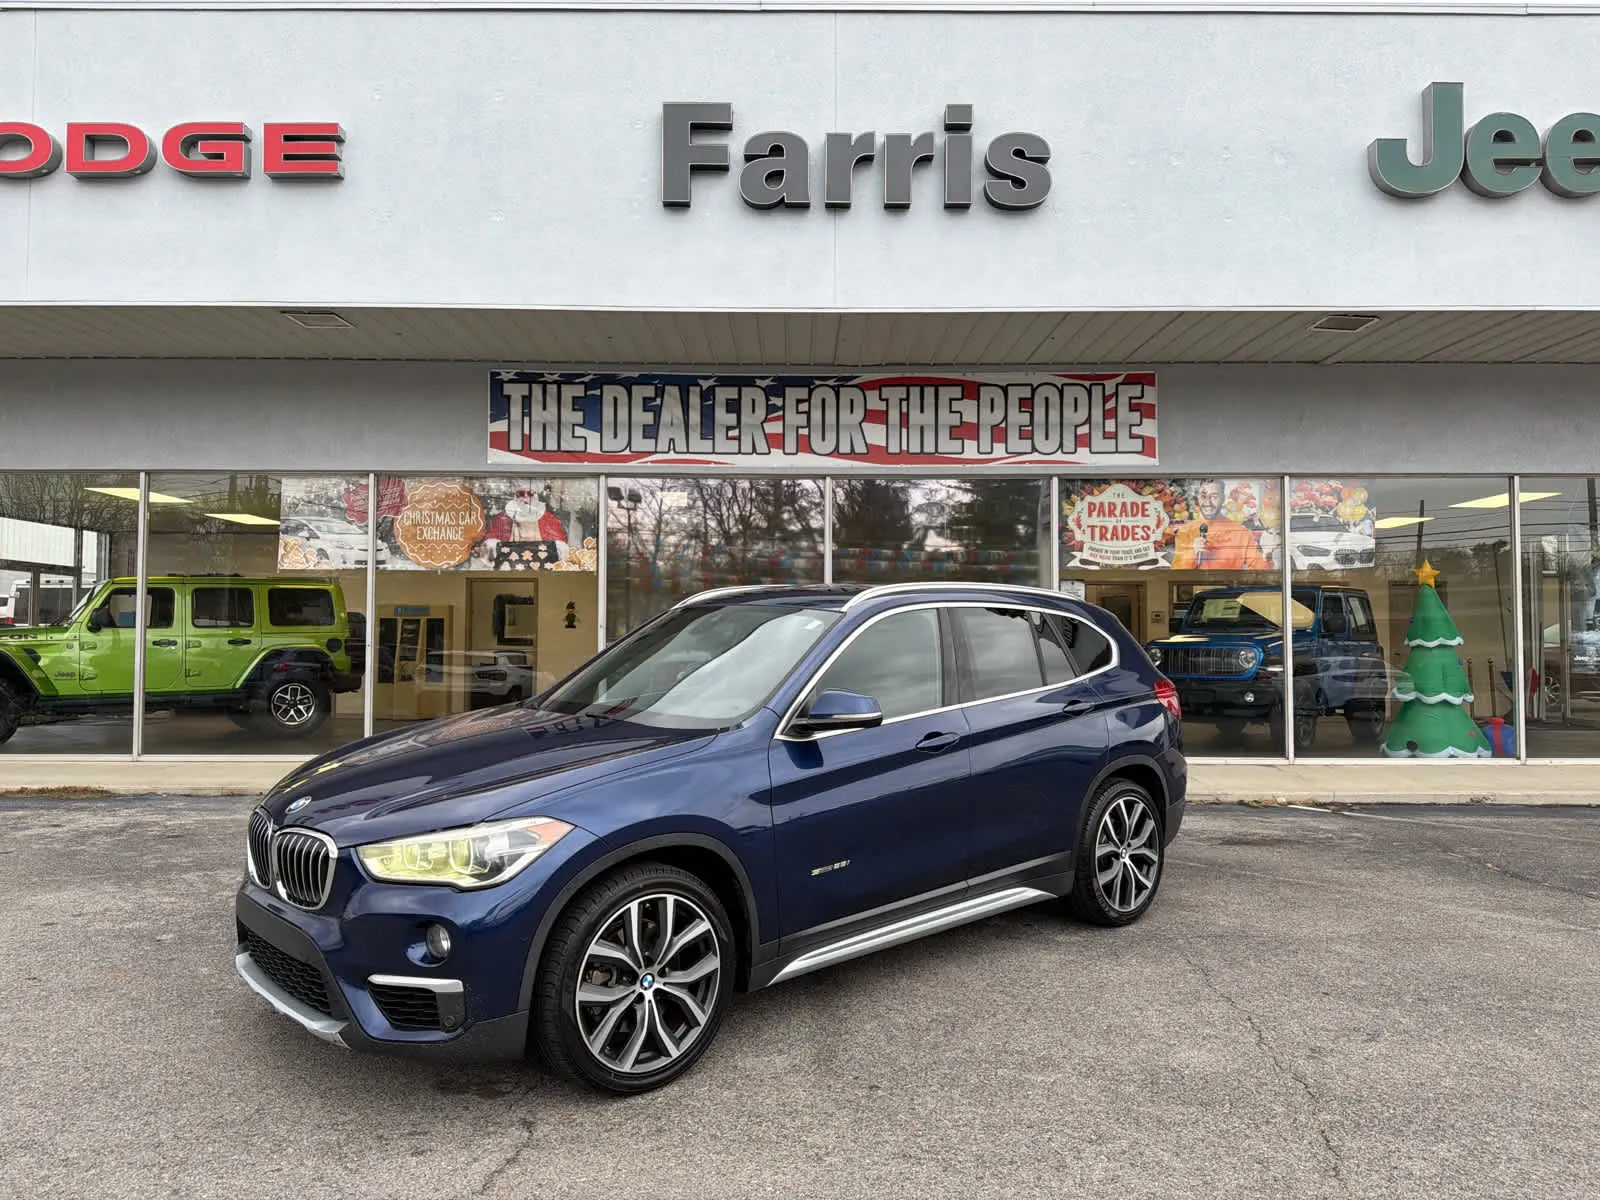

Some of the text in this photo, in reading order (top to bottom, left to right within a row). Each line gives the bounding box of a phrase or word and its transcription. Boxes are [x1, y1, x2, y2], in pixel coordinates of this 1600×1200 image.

[0, 121, 346, 181] ODGE
[661, 101, 1052, 210] Farris
[1367, 81, 1600, 199] Jee
[502, 382, 1145, 456] THE DEALER FOR THE PEOPLE
[403, 510, 478, 526] CHRISTMAS CAR
[1087, 501, 1151, 518] PARADE
[416, 526, 464, 541] EXCHANGE
[1087, 524, 1152, 542] TRADES
